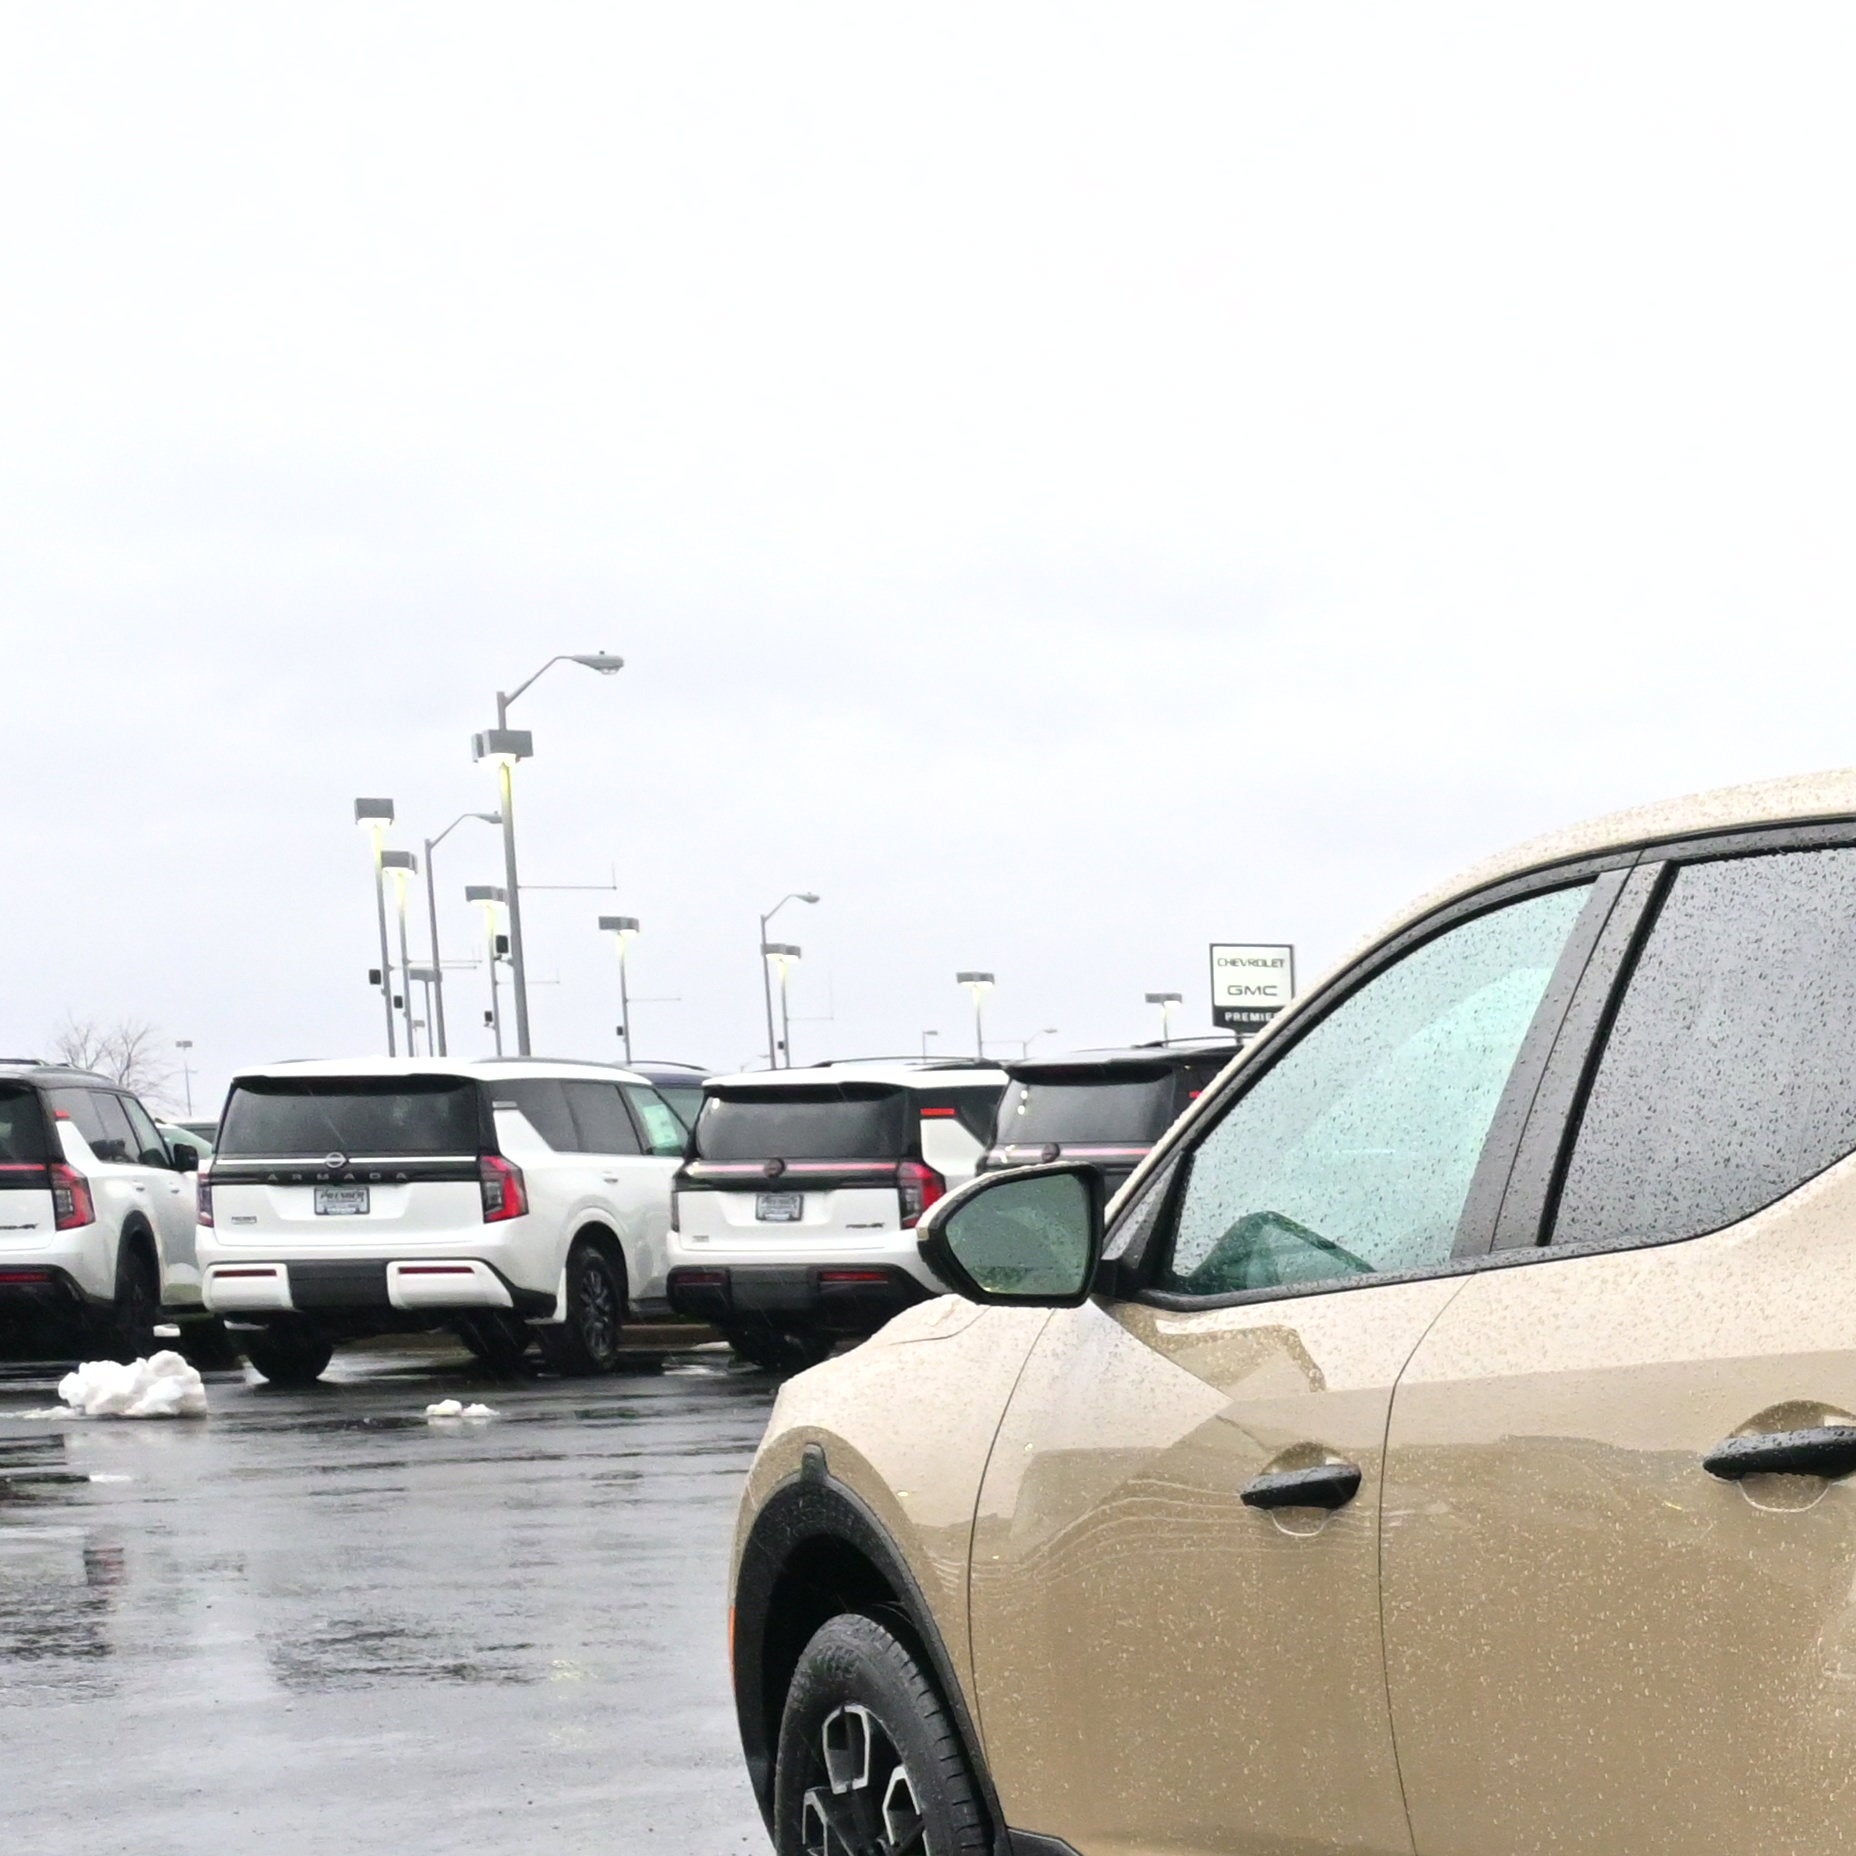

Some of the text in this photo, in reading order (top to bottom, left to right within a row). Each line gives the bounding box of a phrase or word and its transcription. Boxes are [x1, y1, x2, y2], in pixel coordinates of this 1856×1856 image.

[1217, 957, 1285, 968] CHEVROLET
[1227, 985, 1277, 996] GMC
[1224, 1011, 1274, 1022] PREMIE
[267, 1172, 407, 1181] ARMADA
